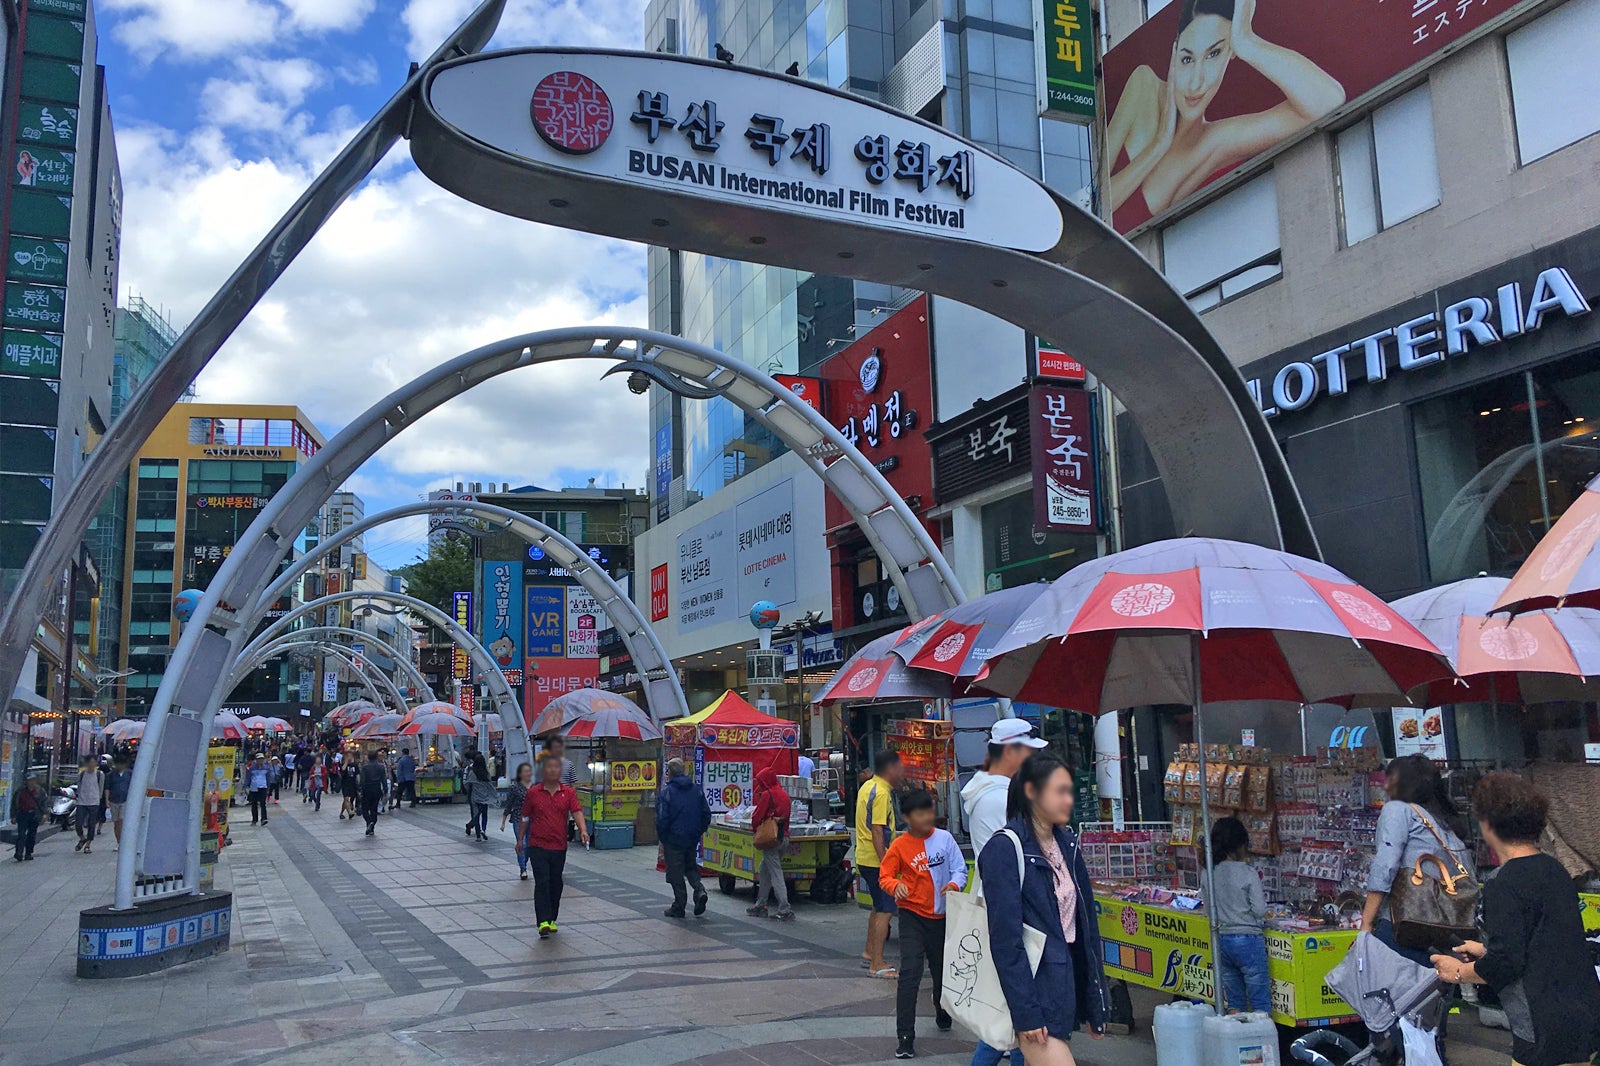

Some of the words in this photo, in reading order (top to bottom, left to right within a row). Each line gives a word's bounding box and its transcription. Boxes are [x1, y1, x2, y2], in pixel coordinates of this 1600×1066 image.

[630, 90, 725, 152] 부산
[744, 113, 830, 175] 국제
[854, 134, 975, 200] 영화제
[37, 172, 72, 185] 노래방
[629, 150, 714, 186] BUSAN
[720, 167, 843, 208] International
[849, 189, 889, 217] Film
[894, 198, 965, 229] Festival
[22, 290, 49, 307] 동천
[7, 307, 62, 324] 노래연습장
[1246, 266, 1592, 418] LOTTERIA
[5, 343, 58, 367] 애플치과
[1042, 359, 1063, 370] 24시간
[968, 415, 1018, 463] 본죽
[1041, 394, 1088, 481] 본죽
[204, 447, 281, 458] ARITAUM
[1052, 505, 1089, 519] 245-8850-1
[738, 519, 776, 553] 롯데시네마
[776, 511, 792, 535] 대영
[681, 538, 703, 563] 유니클로
[744, 560, 762, 577] LOTTE
[762, 552, 787, 569] CINEMA
[652, 569, 666, 593] UNI
[494, 564, 511, 630] 인형뽑기
[652, 593, 667, 618] QLO
[531, 612, 560, 628] VR
[579, 619, 593, 627] 2F
[532, 628, 560, 637] GAME
[568, 644, 586, 655] 1시간
[537, 677, 598, 692] 임대문의
[718, 728, 749, 745] 쪽집게
[901, 740, 932, 757] 씨앗호떡
[707, 762, 751, 783] 남녀궁합
[706, 787, 722, 806] 경력
[724, 788, 740, 807] 30
[742, 788, 752, 807] 년
[1144, 912, 1187, 933] BUSAN
[119, 938, 133, 947] BIFF
[1145, 927, 1191, 947] International
[1192, 937, 1209, 950] Film
